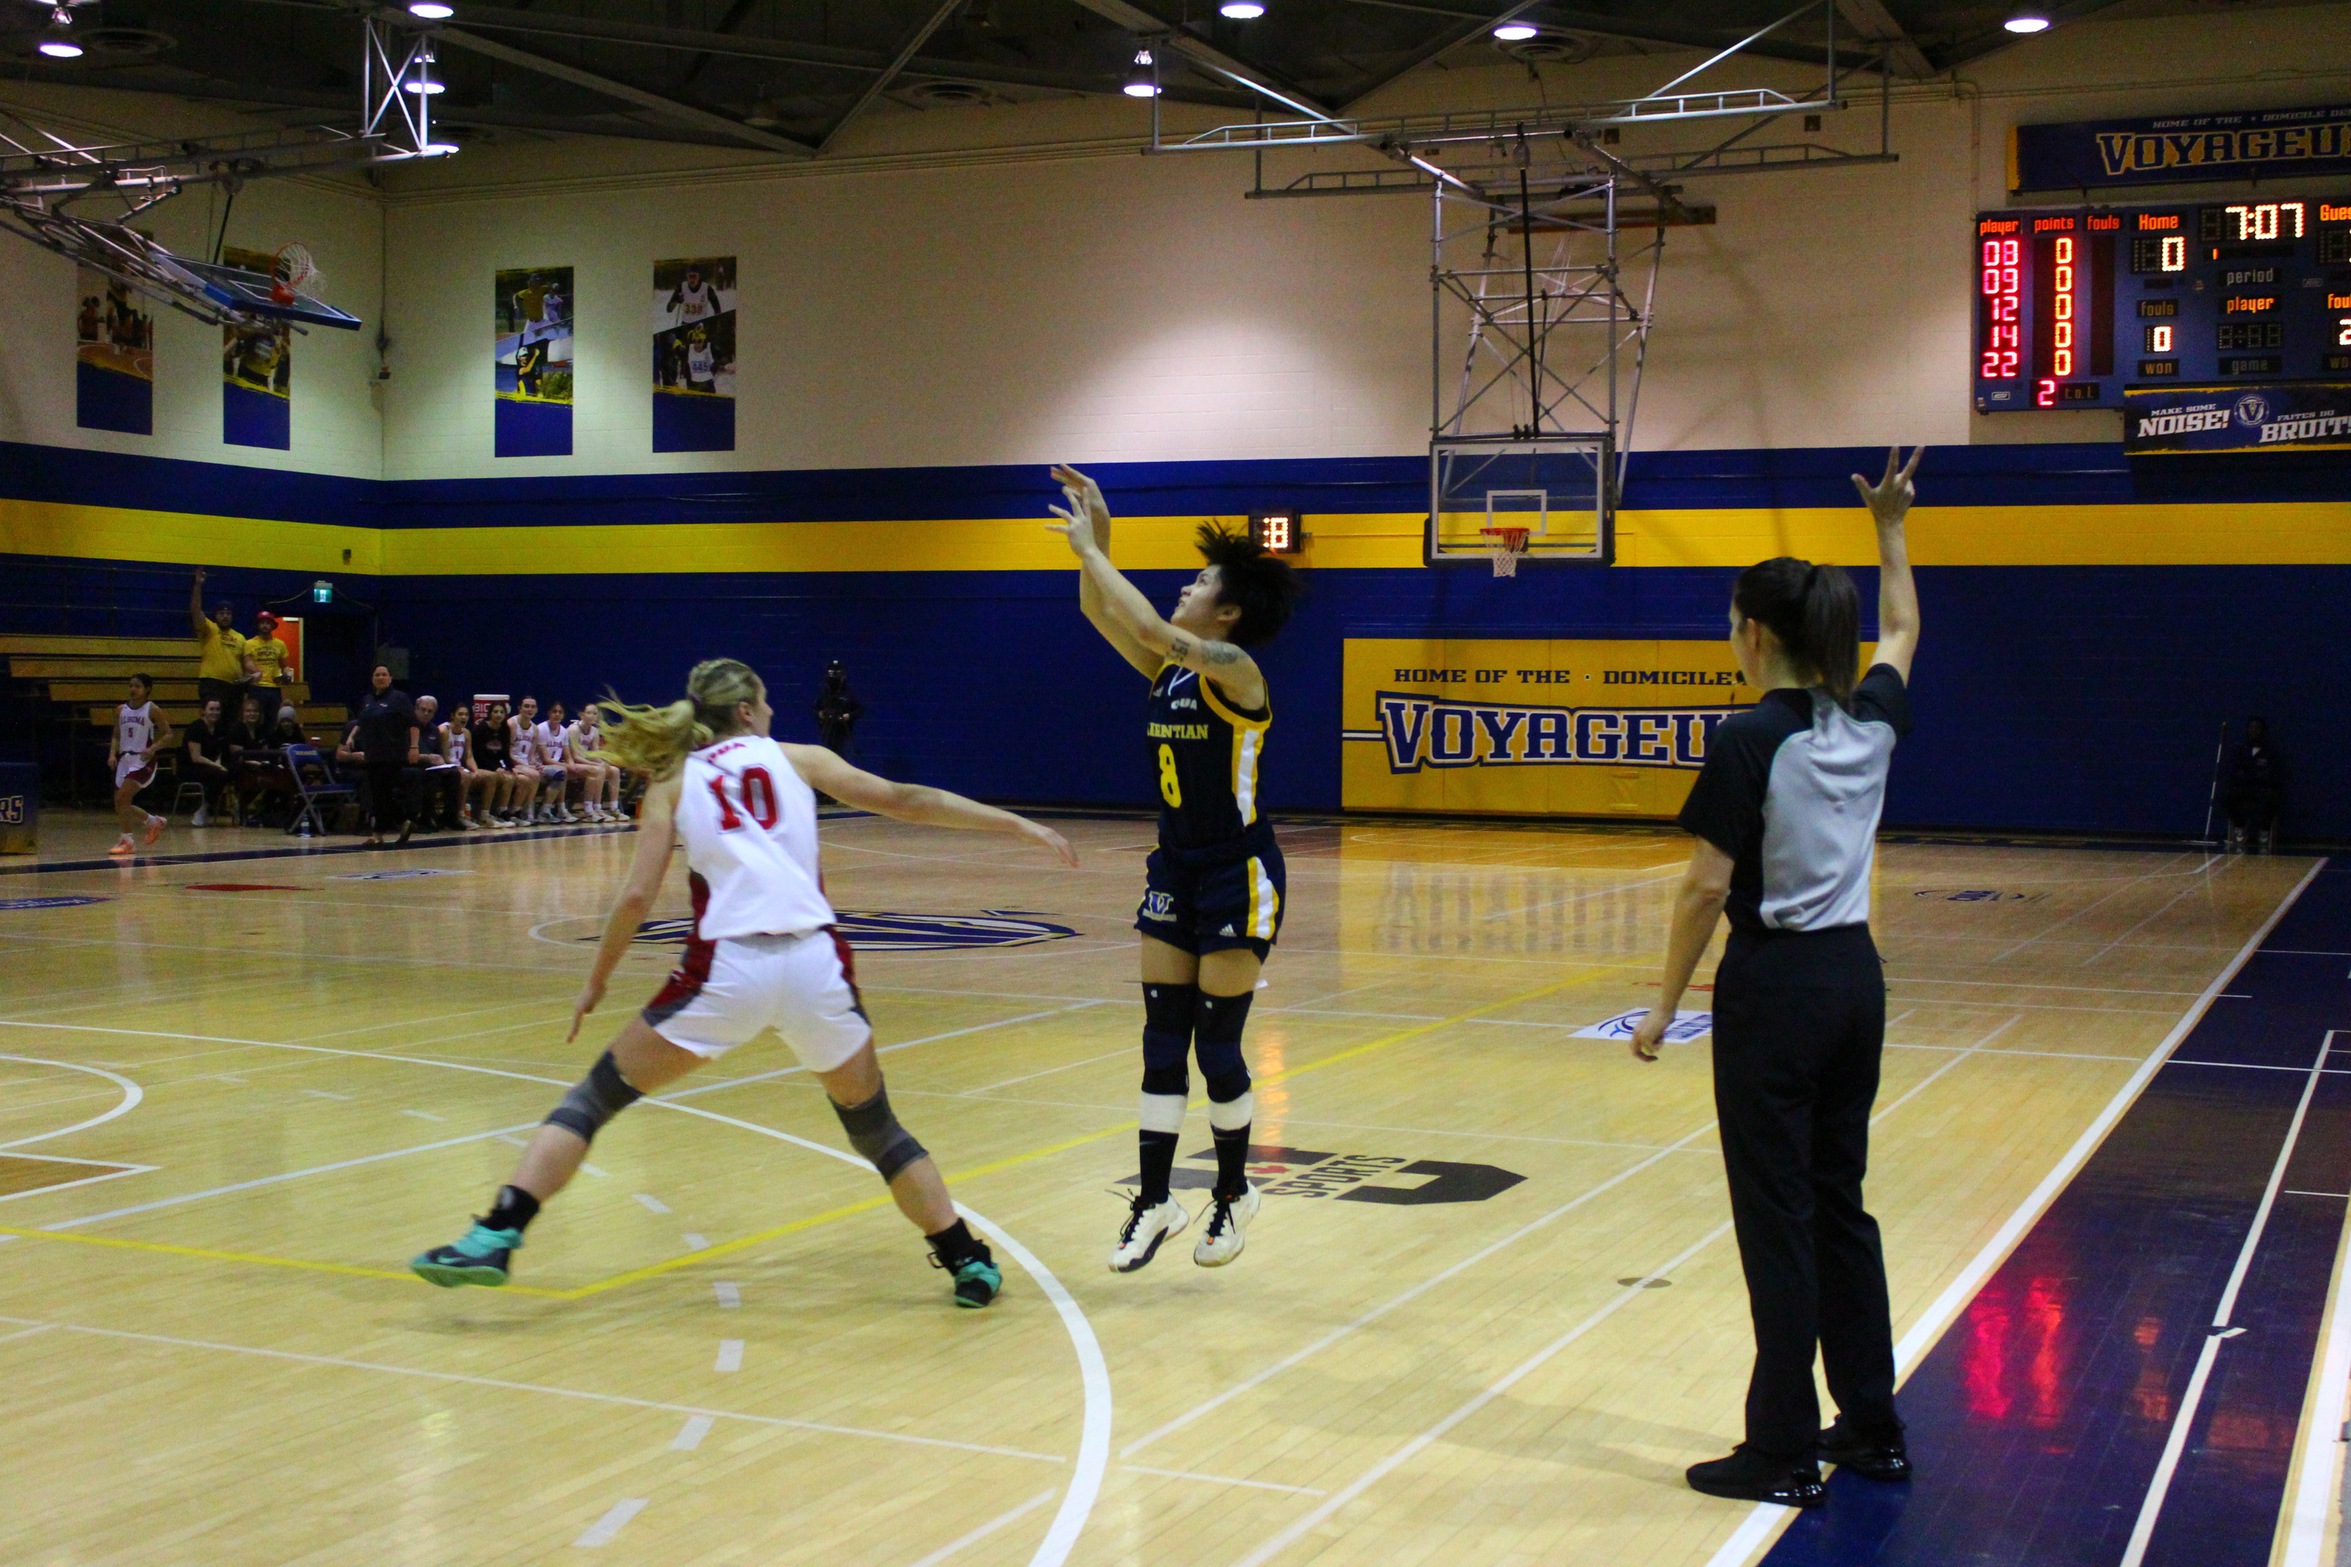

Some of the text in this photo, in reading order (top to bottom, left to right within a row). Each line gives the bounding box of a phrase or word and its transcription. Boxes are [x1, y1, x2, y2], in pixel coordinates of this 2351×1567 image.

[2153, 119, 2189, 129] HOME
[2194, 118, 2211, 127] OF
[2215, 116, 2242, 125] THE
[2262, 110, 2325, 122] DOMICILE
[2097, 124, 2351, 175] VOYAGEU
[1980, 215, 2120, 236] player points fouls
[2139, 213, 2179, 230] Home
[2225, 202, 2304, 240] 7:07
[1983, 237, 2072, 266] 08 0
[2162, 236, 2185, 272] 0
[1983, 266, 2072, 294] 09 0
[2227, 268, 2274, 285] period
[1992, 293, 2072, 321] 12 0
[2141, 301, 2175, 316] fouls
[2227, 296, 2275, 314] player
[2327, 293, 2351, 309] fou
[1992, 322, 2072, 348] 14 0
[2153, 326, 2172, 352] 0
[1982, 350, 2071, 377] 22 0
[2145, 362, 2173, 375] won
[2232, 358, 2269, 375] game
[2037, 380, 2055, 406] 2
[2137, 409, 2231, 438] NOISE!
[2151, 404, 2216, 417] MAKE SOME
[2277, 411, 2316, 422] FAITES
[1394, 668, 1732, 686] HOME OF THE DOMICILE
[1158, 743, 1182, 808] 8
[709, 767, 778, 830] 10
[1261, 1154, 1406, 1199] SPORTS
